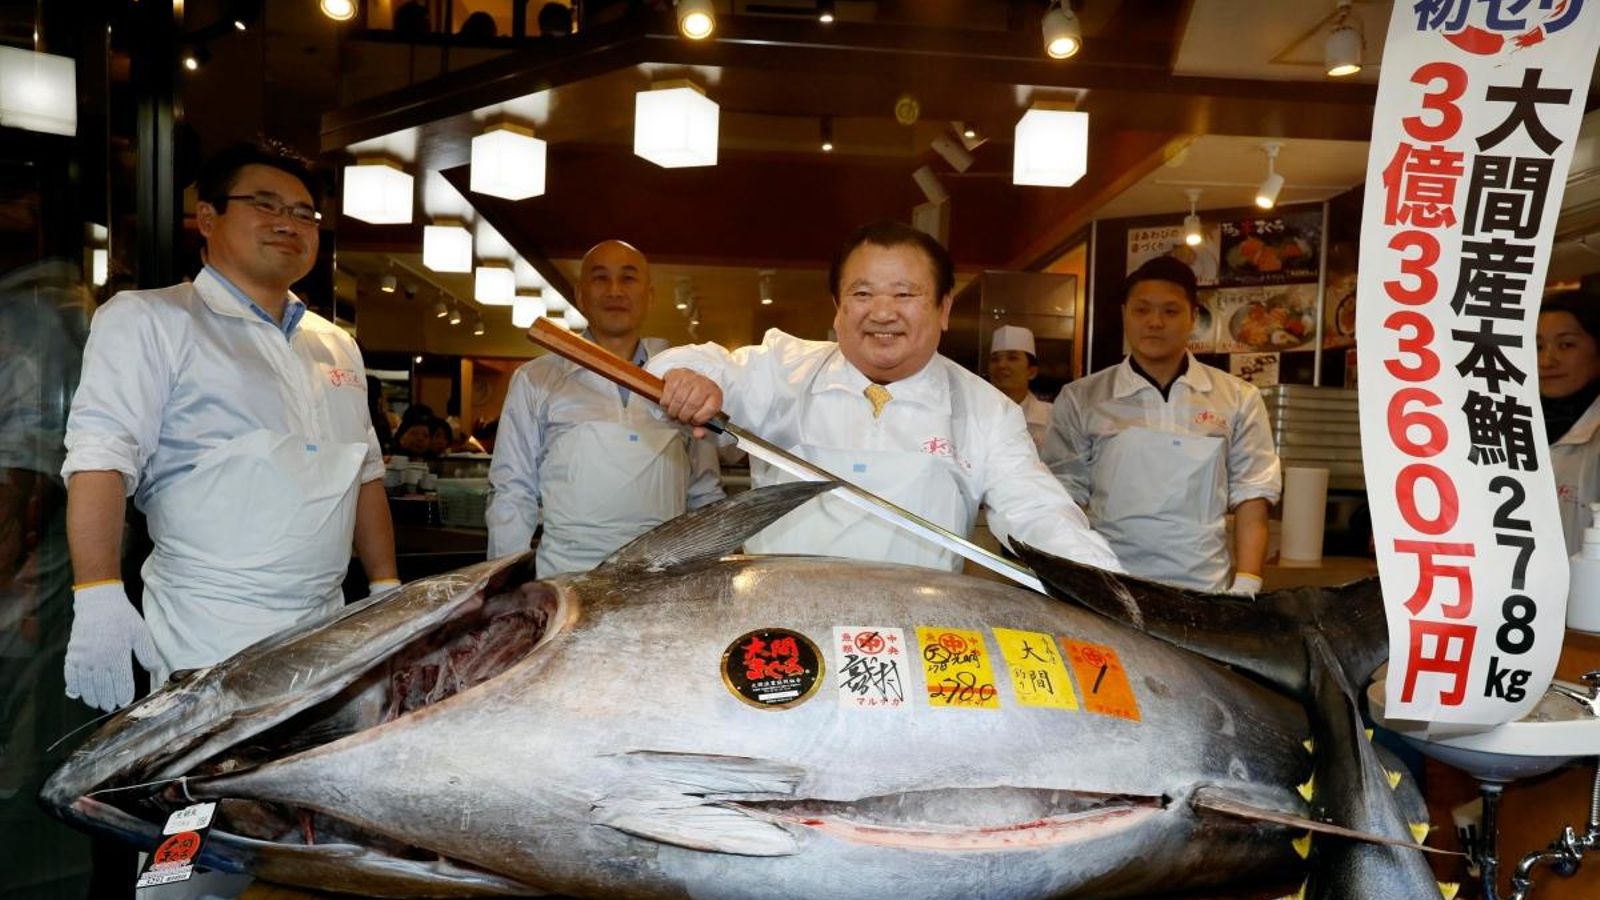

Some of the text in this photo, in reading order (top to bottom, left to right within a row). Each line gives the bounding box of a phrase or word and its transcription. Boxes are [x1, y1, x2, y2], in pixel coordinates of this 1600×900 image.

[1382, 62, 1478, 706] 3億3360万円
[743, 637, 799, 660] 大間
[1021, 640, 1054, 695] 大間
